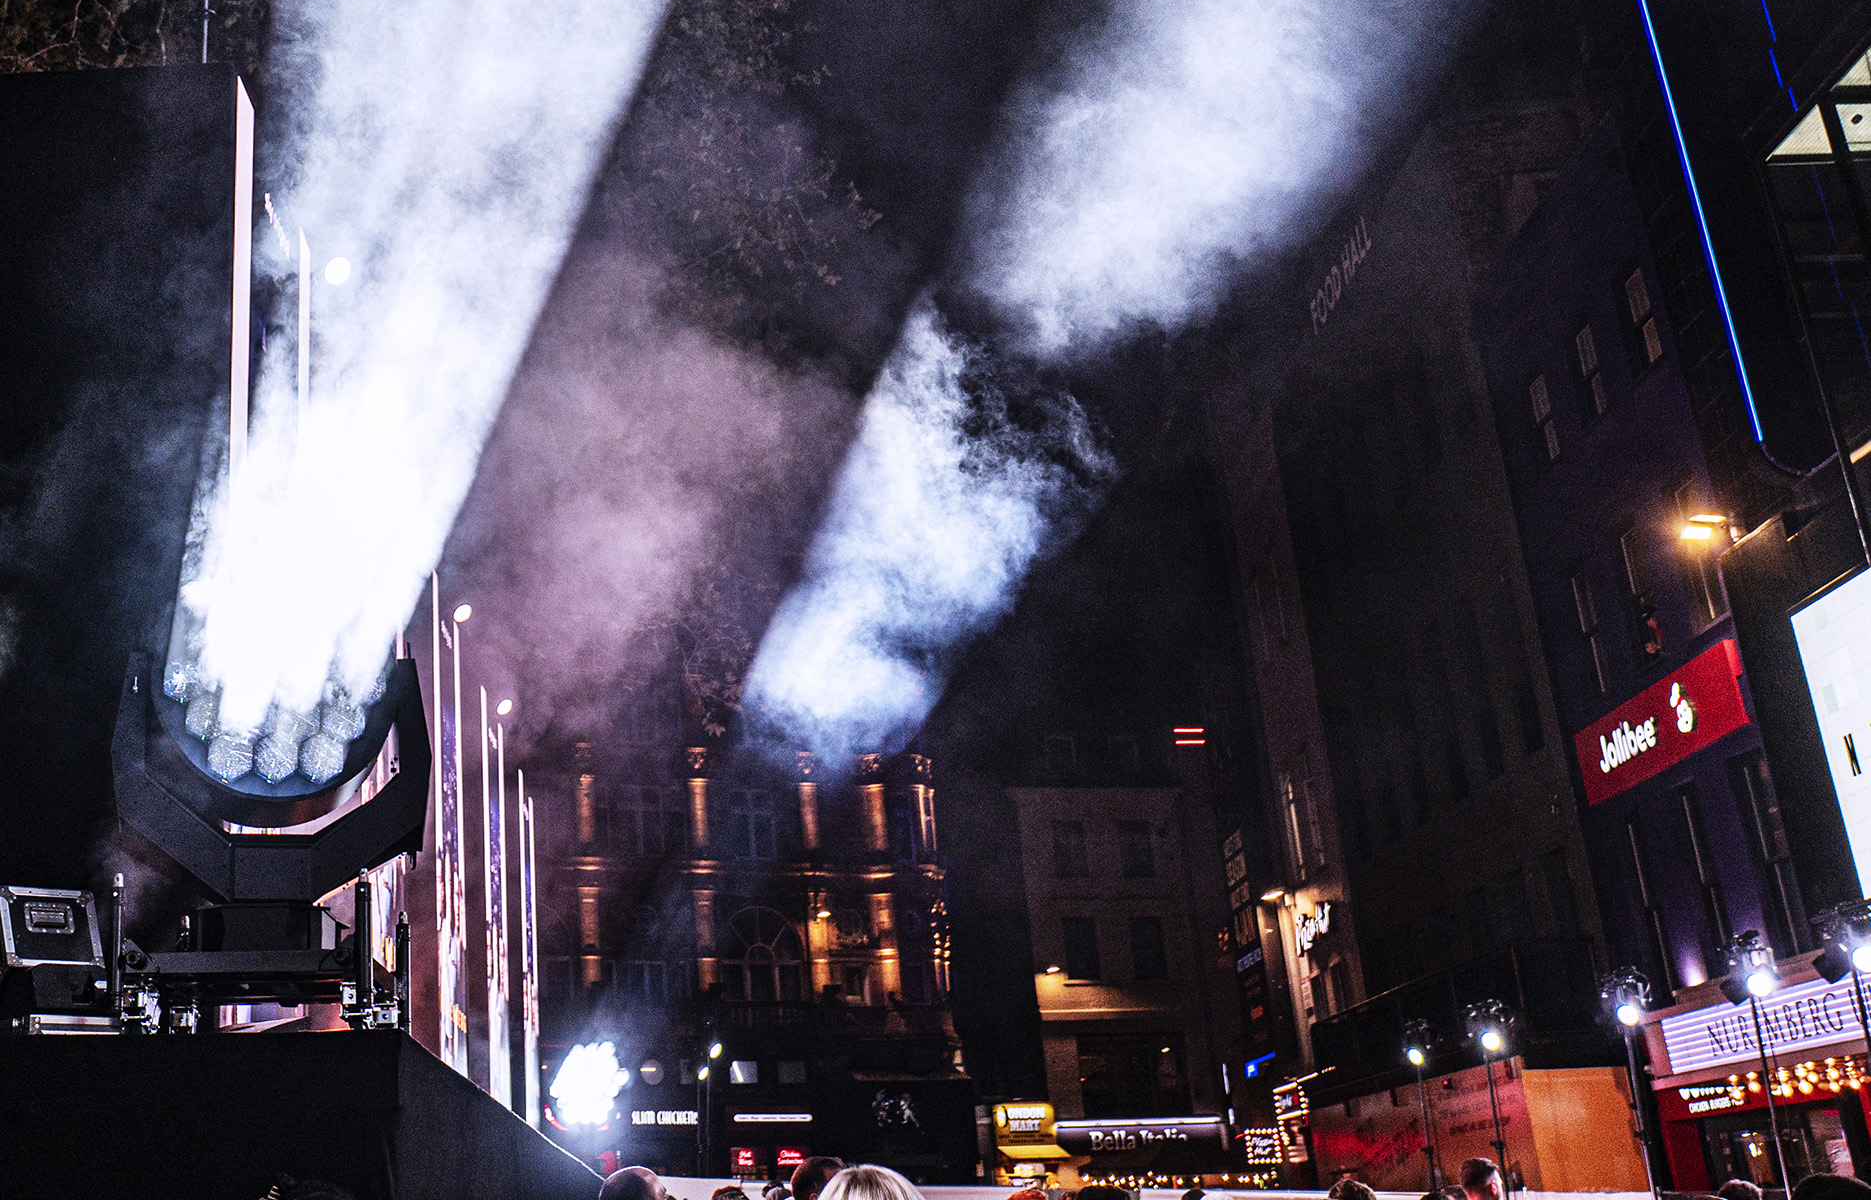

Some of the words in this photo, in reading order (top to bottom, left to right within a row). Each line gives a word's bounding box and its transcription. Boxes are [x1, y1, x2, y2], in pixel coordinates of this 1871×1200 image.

[1600, 719, 1656, 773] Jollibee
[1707, 993, 1843, 1056] NURMBERG
[1088, 1129, 1136, 1151] Bella
